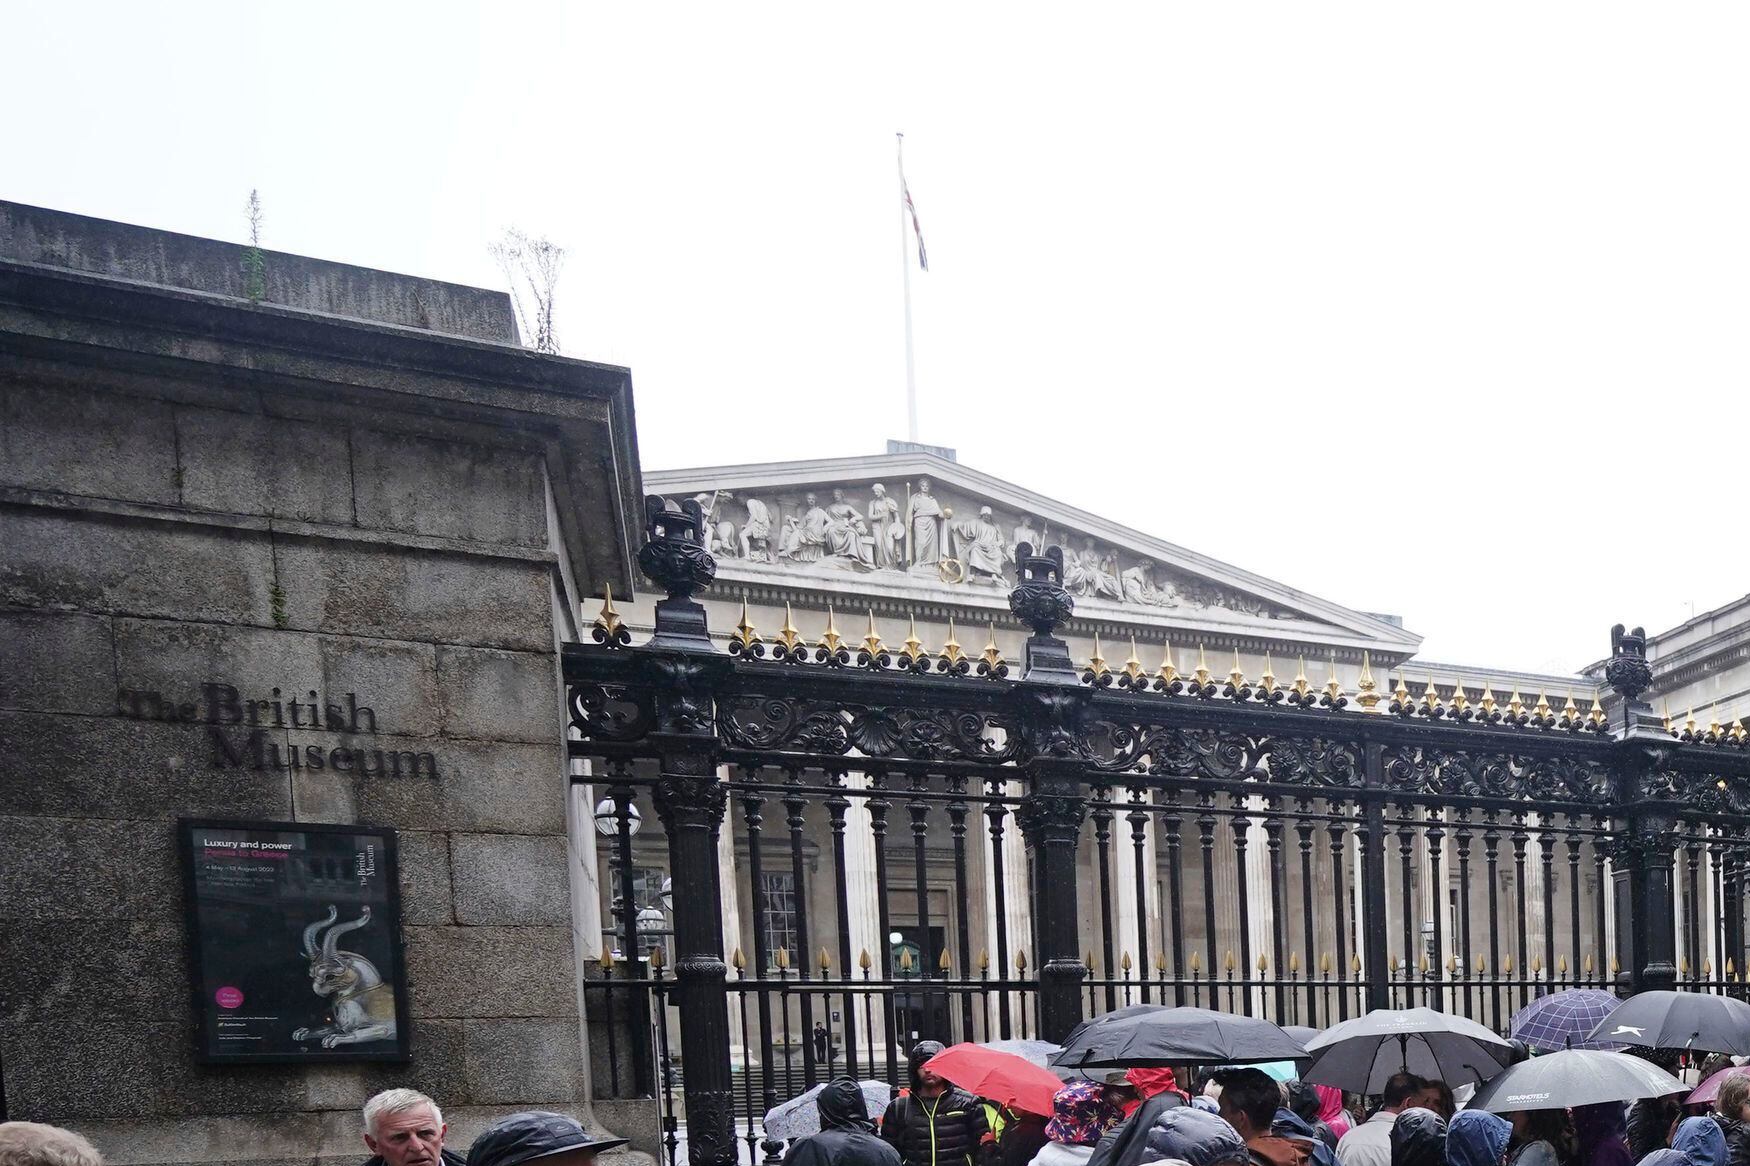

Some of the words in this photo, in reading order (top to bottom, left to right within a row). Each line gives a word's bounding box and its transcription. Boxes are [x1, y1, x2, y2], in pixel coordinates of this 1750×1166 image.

[119, 689, 199, 719] The
[201, 682, 382, 734] British
[207, 728, 442, 780] Museum
[204, 839, 238, 849] Luxury
[240, 841, 259, 849] and
[261, 842, 292, 851] power
[251, 850, 288, 859] Greece
[356, 852, 366, 876] British
[367, 845, 375, 876] Museum
